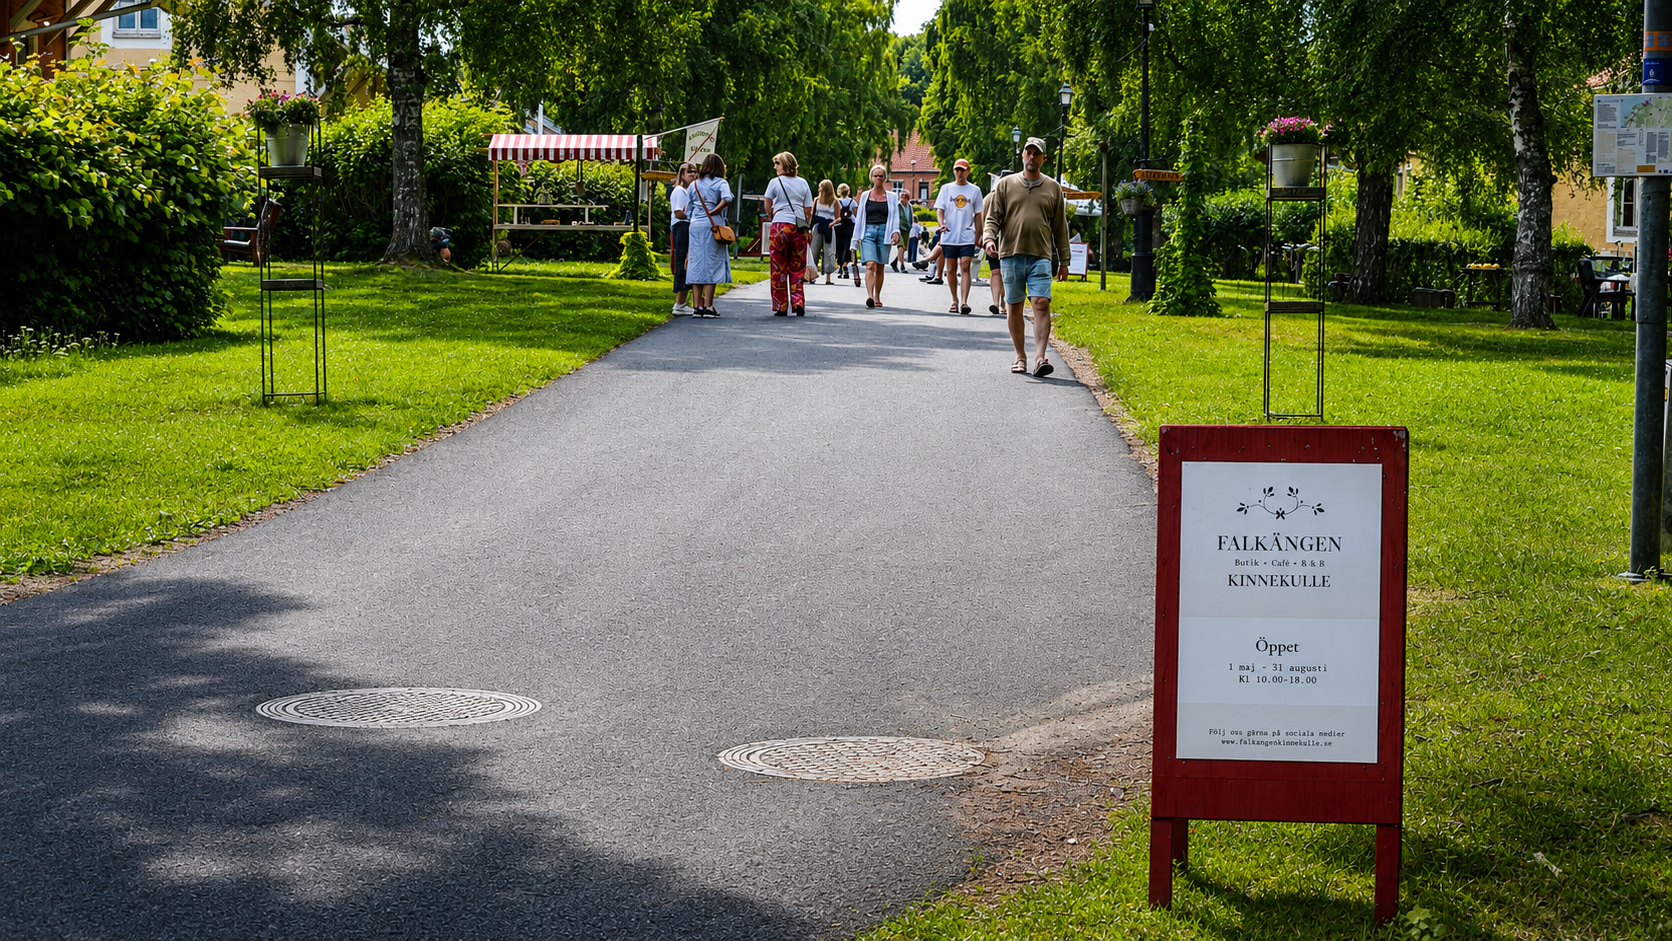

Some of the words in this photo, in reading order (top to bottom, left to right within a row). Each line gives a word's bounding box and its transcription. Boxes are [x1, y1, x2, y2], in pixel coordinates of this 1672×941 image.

[1217, 532, 1343, 552] FALKÄNGEN
[1234, 558, 1259, 567] Butik
[1271, 559, 1290, 567] Café
[1227, 573, 1331, 588] KINNEKULLE
[1255, 636, 1300, 657] Öppet
[1228, 663, 1234, 671] 1
[1238, 663, 1255, 673] maj
[1272, 663, 1283, 672] 31
[1289, 664, 1328, 674] augusti
[1238, 675, 1250, 684] Kl
[1256, 675, 1317, 684] 10.00-18.00
[1208, 728, 1226, 737] Följ
[1246, 729, 1269, 737] gärna
[1271, 729, 1281, 737] på
[1284, 729, 1315, 737] sociala
[1220, 738, 1333, 747] www.falkangenkinnekulle.se
